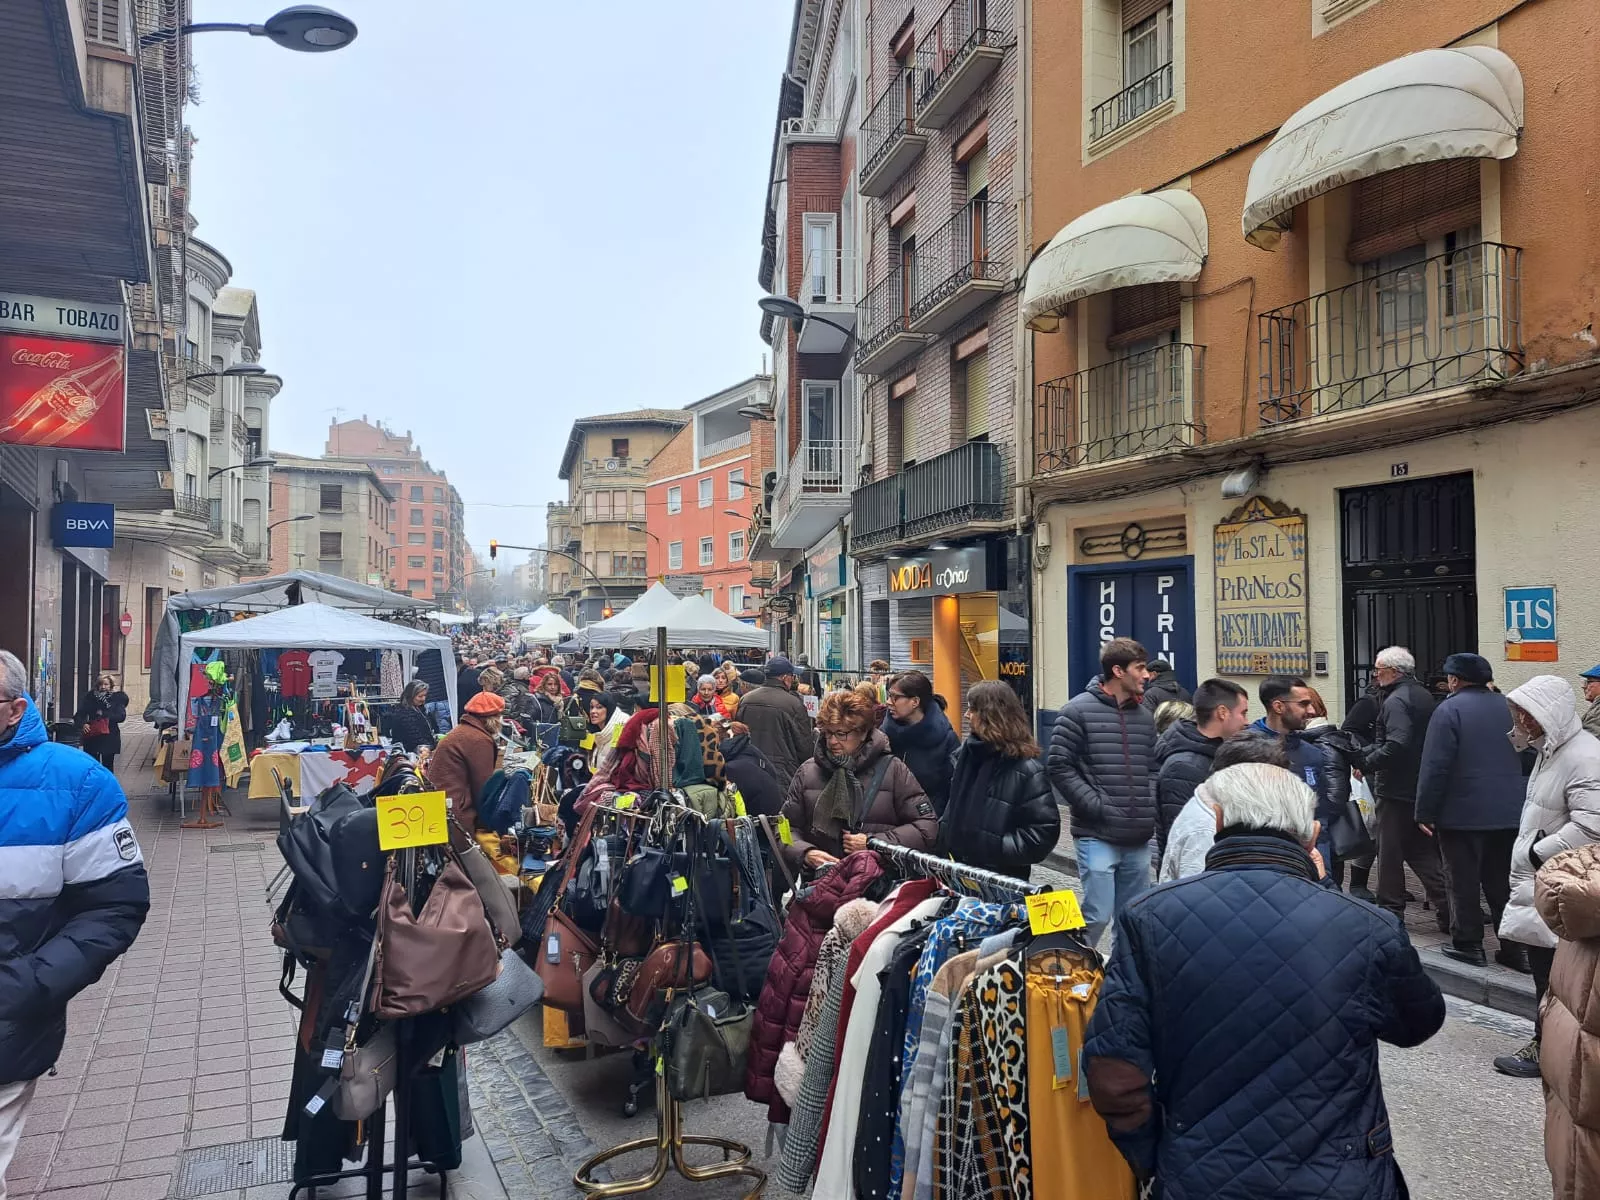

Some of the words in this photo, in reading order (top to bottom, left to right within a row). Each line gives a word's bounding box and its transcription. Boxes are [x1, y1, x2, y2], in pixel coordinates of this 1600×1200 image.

[0, 300, 35, 322] BAR
[56, 307, 119, 331] TOBAZO
[66, 519, 109, 530] BBVA
[891, 562, 932, 593] MODA
[1508, 598, 1552, 629] HS
[1220, 611, 1302, 648] RESTAURANTE
[1000, 662, 1025, 676] MODA
